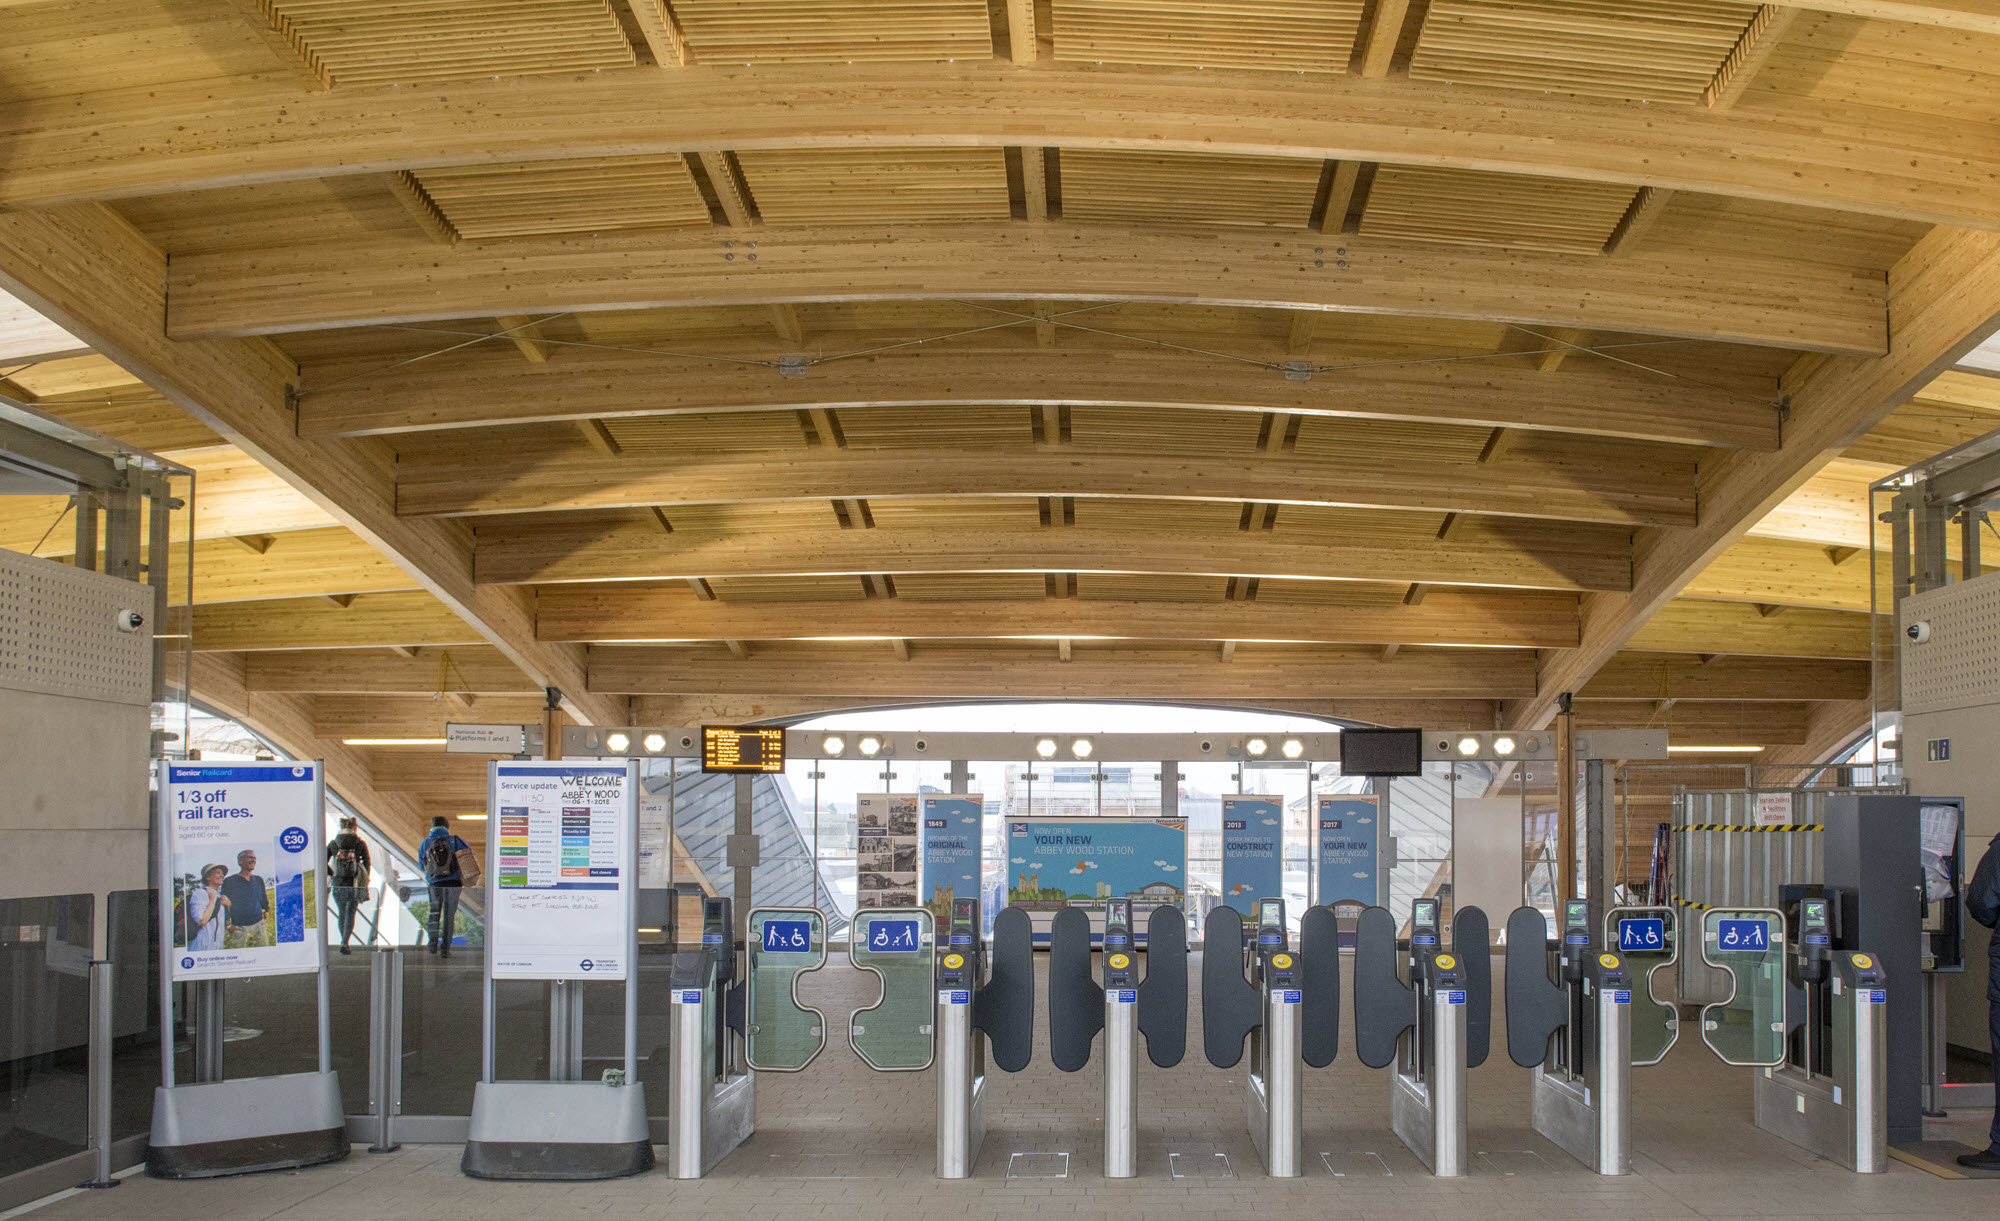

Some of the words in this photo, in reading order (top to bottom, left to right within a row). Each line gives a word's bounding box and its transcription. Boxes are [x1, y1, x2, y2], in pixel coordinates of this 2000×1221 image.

[560, 776, 622, 786] WELCOME
[530, 782, 558, 791] update
[178, 790, 201, 804] 1/3
[204, 790, 227, 803] off
[561, 790, 592, 799] ABBEY
[594, 790, 620, 799] WOOD
[178, 806, 203, 820] rail
[207, 806, 254, 818] fares.
[284, 835, 305, 844] £30
[1034, 836, 1063, 844] YOUR
[1066, 836, 1092, 844] NEW
[1034, 846, 1063, 855] ABBEY
[1067, 846, 1094, 854] WOOD
[1096, 846, 1134, 854] STATION
